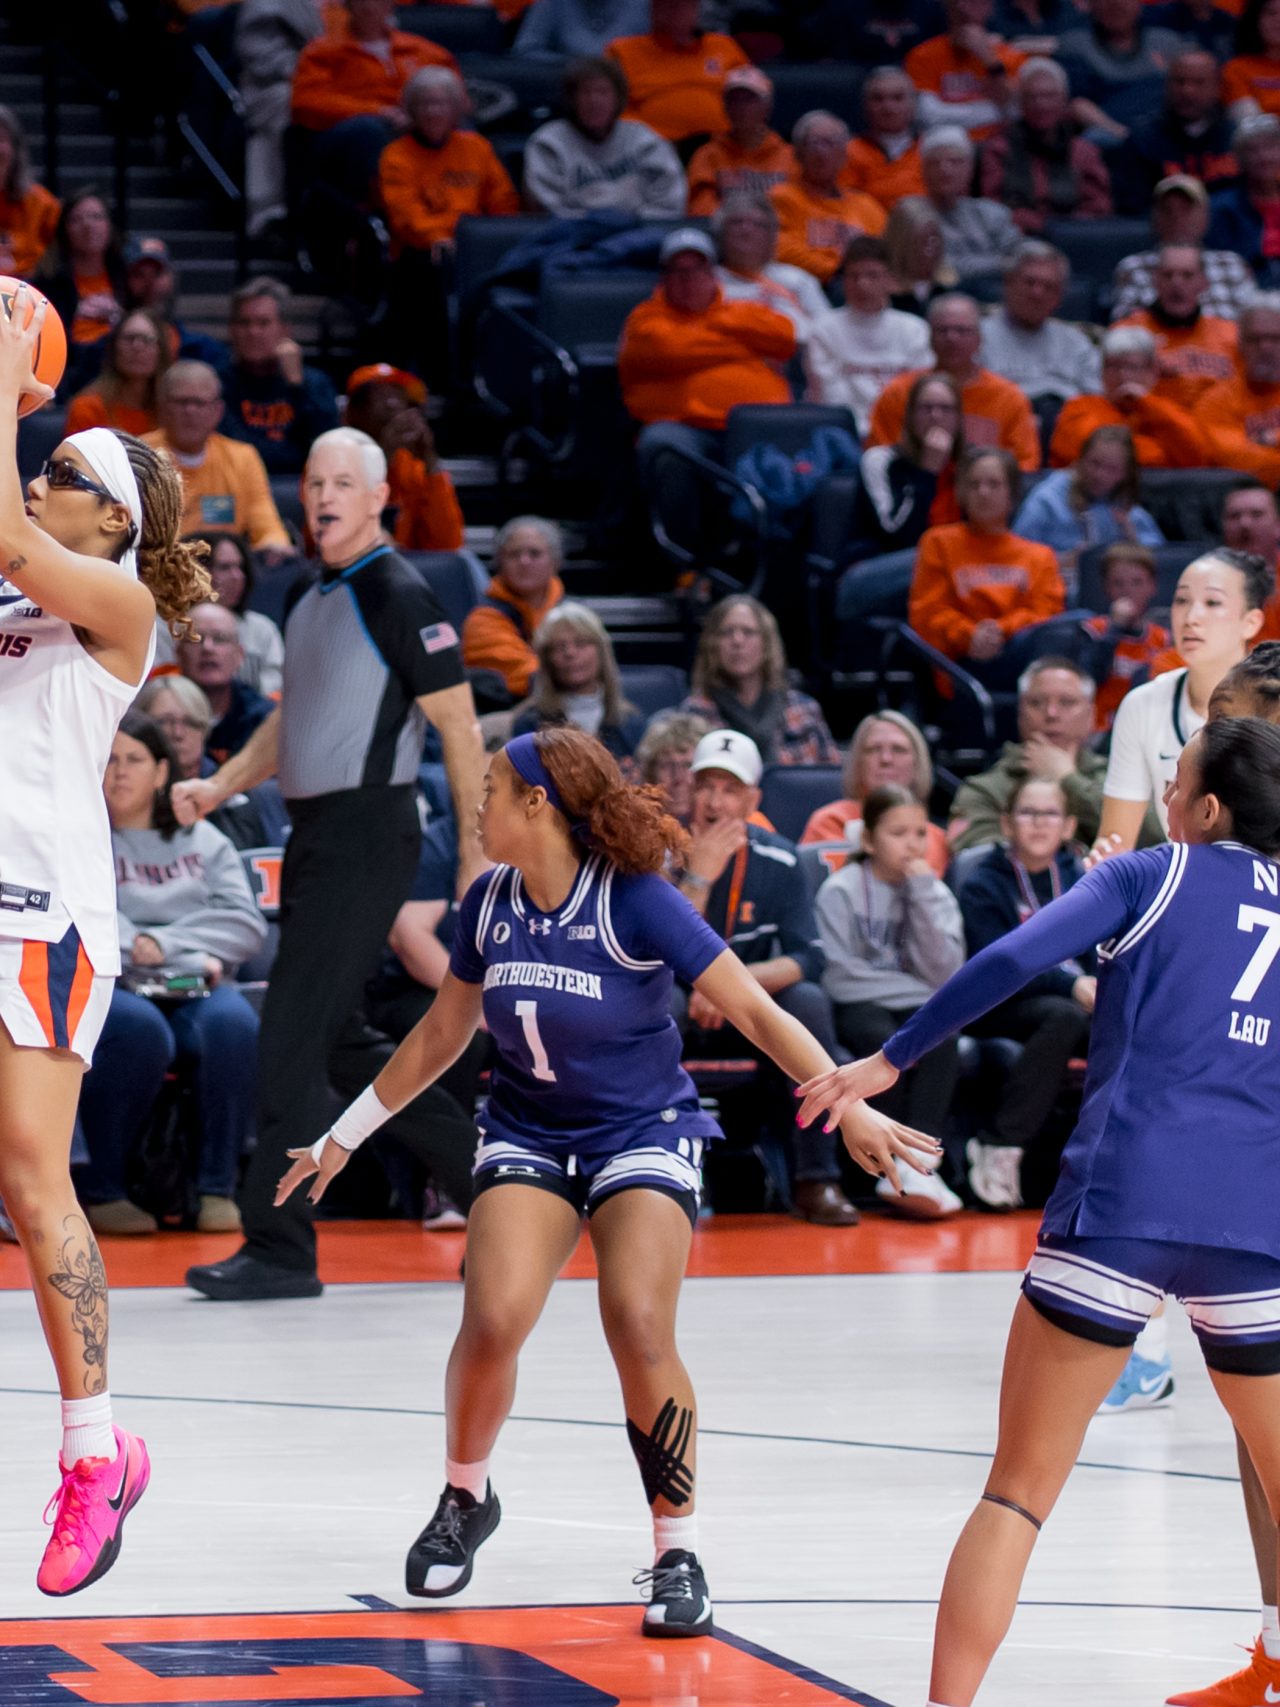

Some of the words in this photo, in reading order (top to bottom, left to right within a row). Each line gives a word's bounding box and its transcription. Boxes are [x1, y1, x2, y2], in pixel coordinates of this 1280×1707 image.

[1252, 859, 1278, 896] N
[29, 893, 41, 905] 42
[1231, 904, 1280, 1002] 7
[515, 1001, 557, 1082] 1
[1228, 1011, 1271, 1046] LAU
